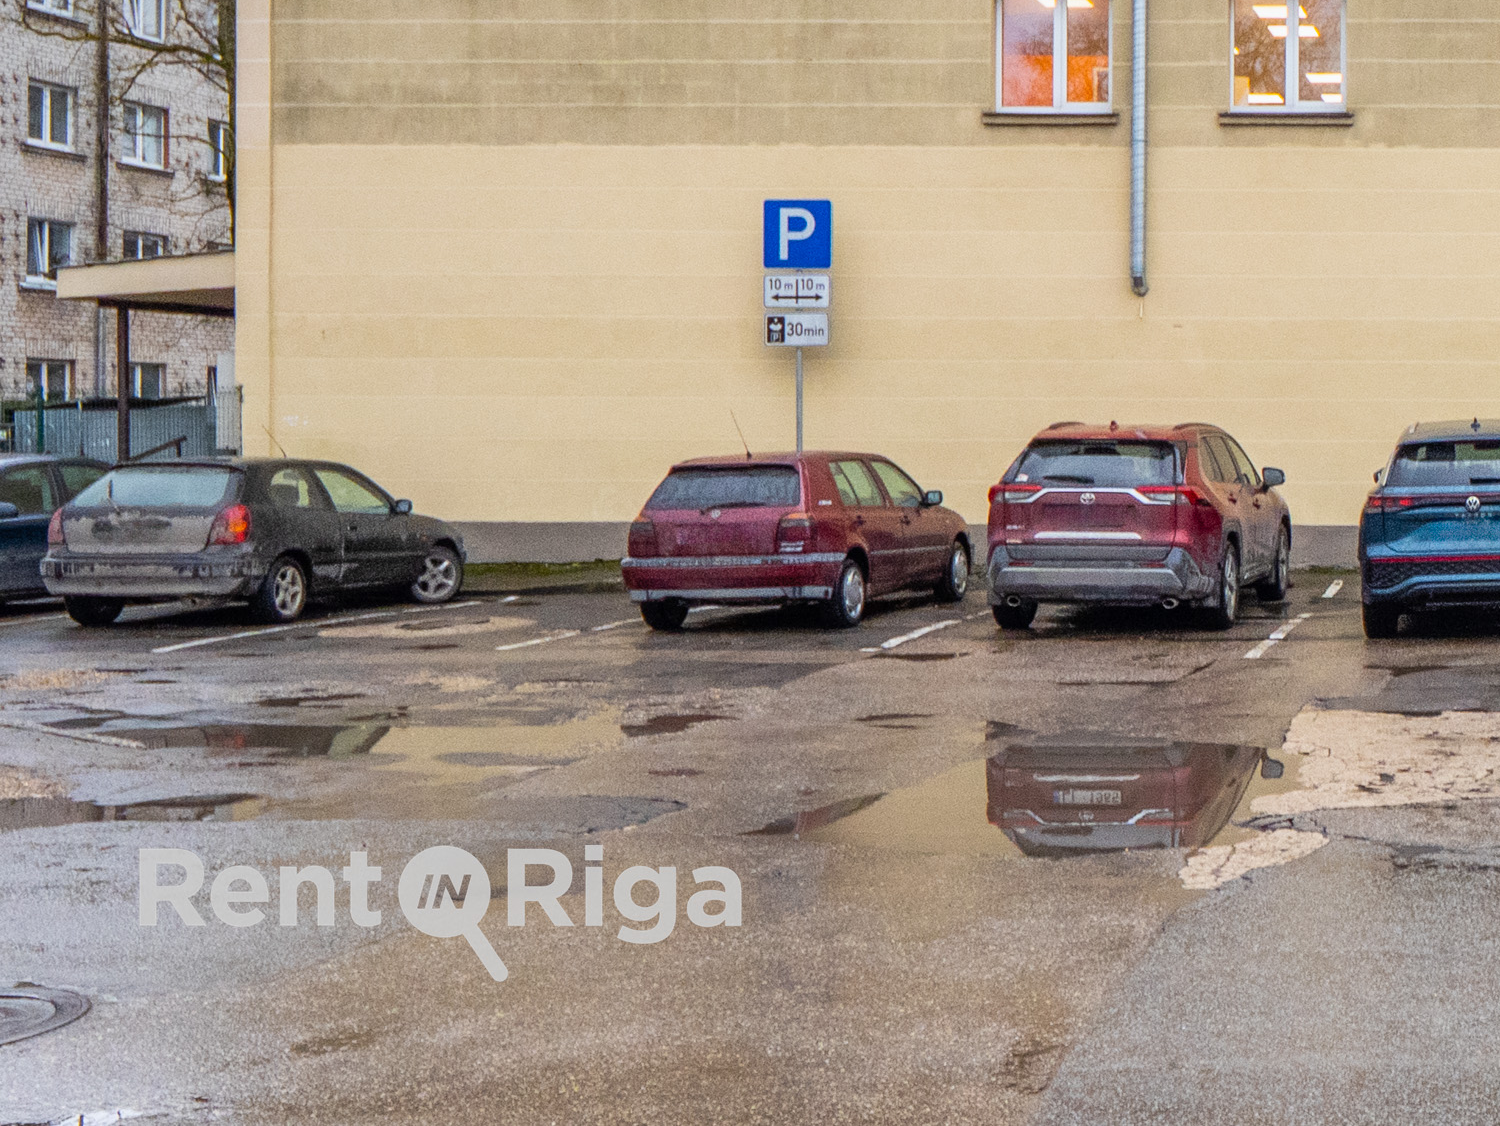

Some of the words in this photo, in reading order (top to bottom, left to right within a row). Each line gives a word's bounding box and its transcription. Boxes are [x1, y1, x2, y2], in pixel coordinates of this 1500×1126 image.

[779, 207, 815, 261] P
[769, 278, 781, 290] 10
[801, 278, 813, 290] 10
